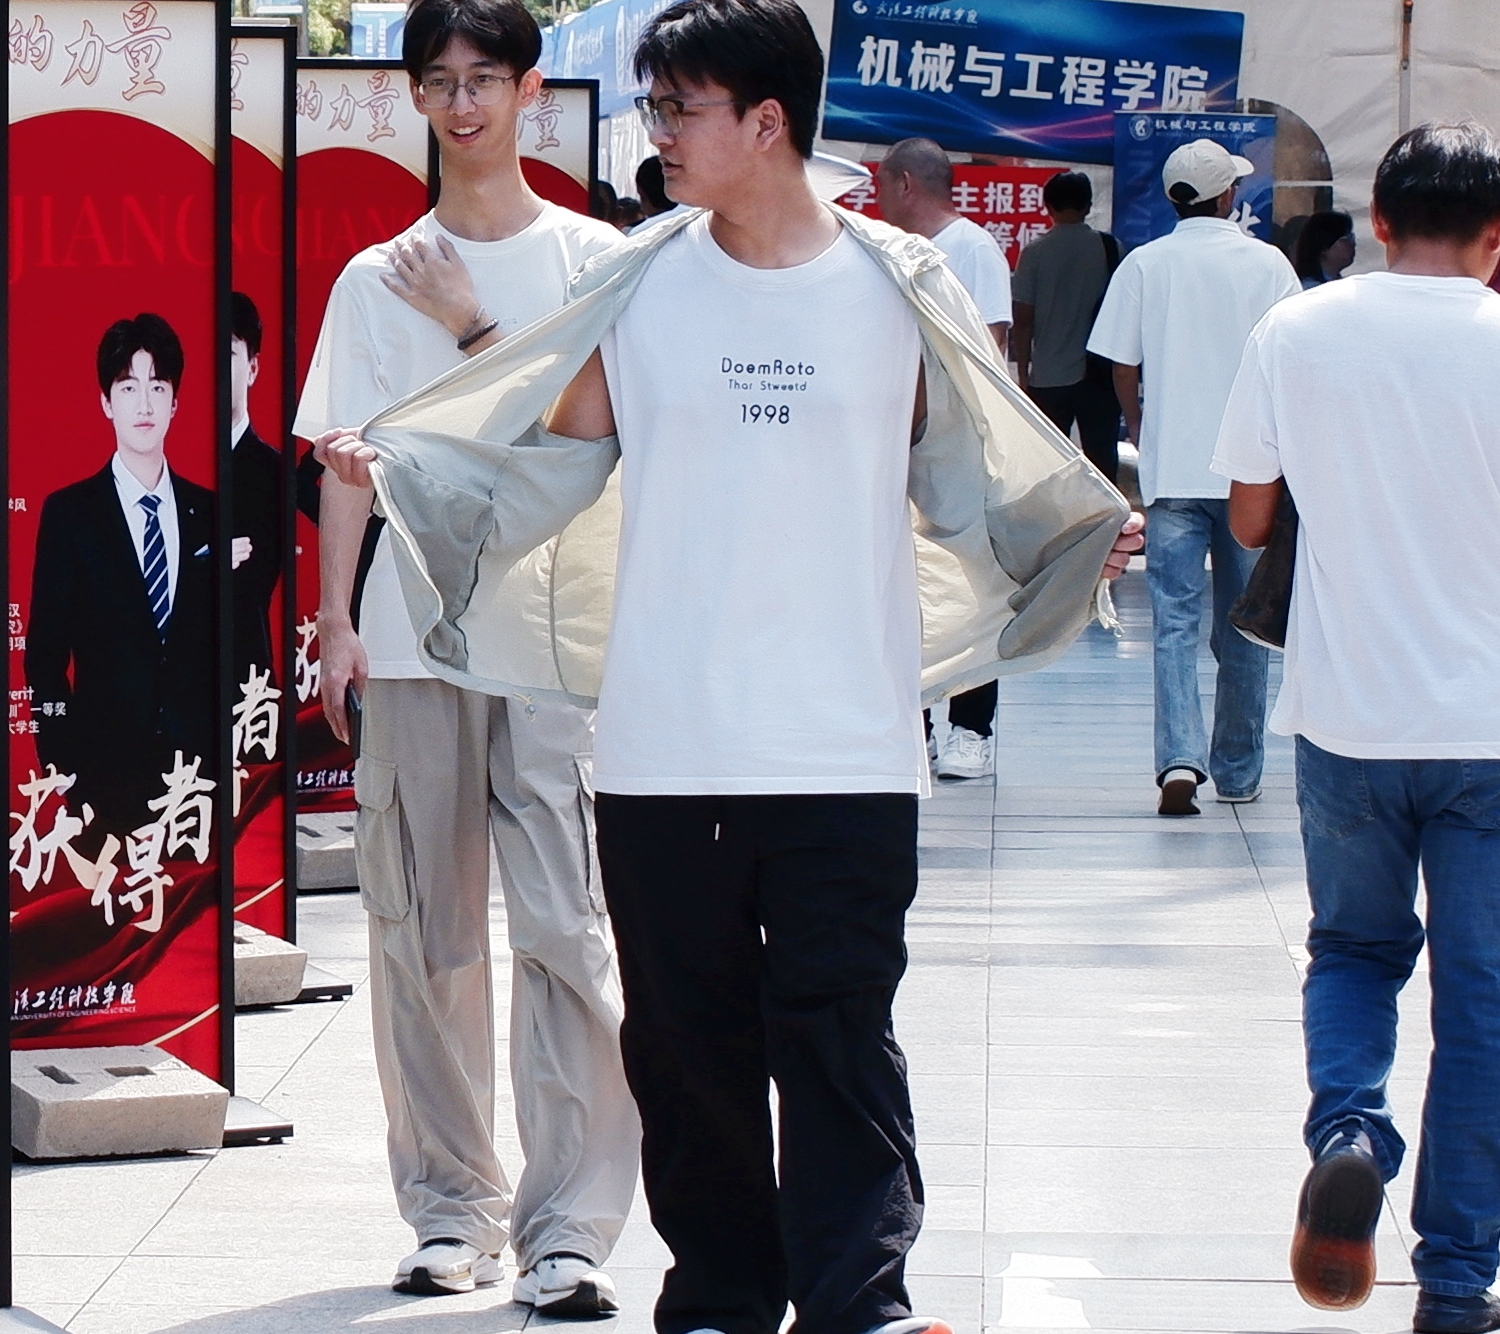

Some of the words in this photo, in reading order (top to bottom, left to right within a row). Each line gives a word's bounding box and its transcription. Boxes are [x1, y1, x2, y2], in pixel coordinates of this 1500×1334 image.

[857, 35, 1209, 113] 机械与工程学院
[1154, 118, 1257, 134] 机械与工程学院
[741, 404, 790, 425] 1998
